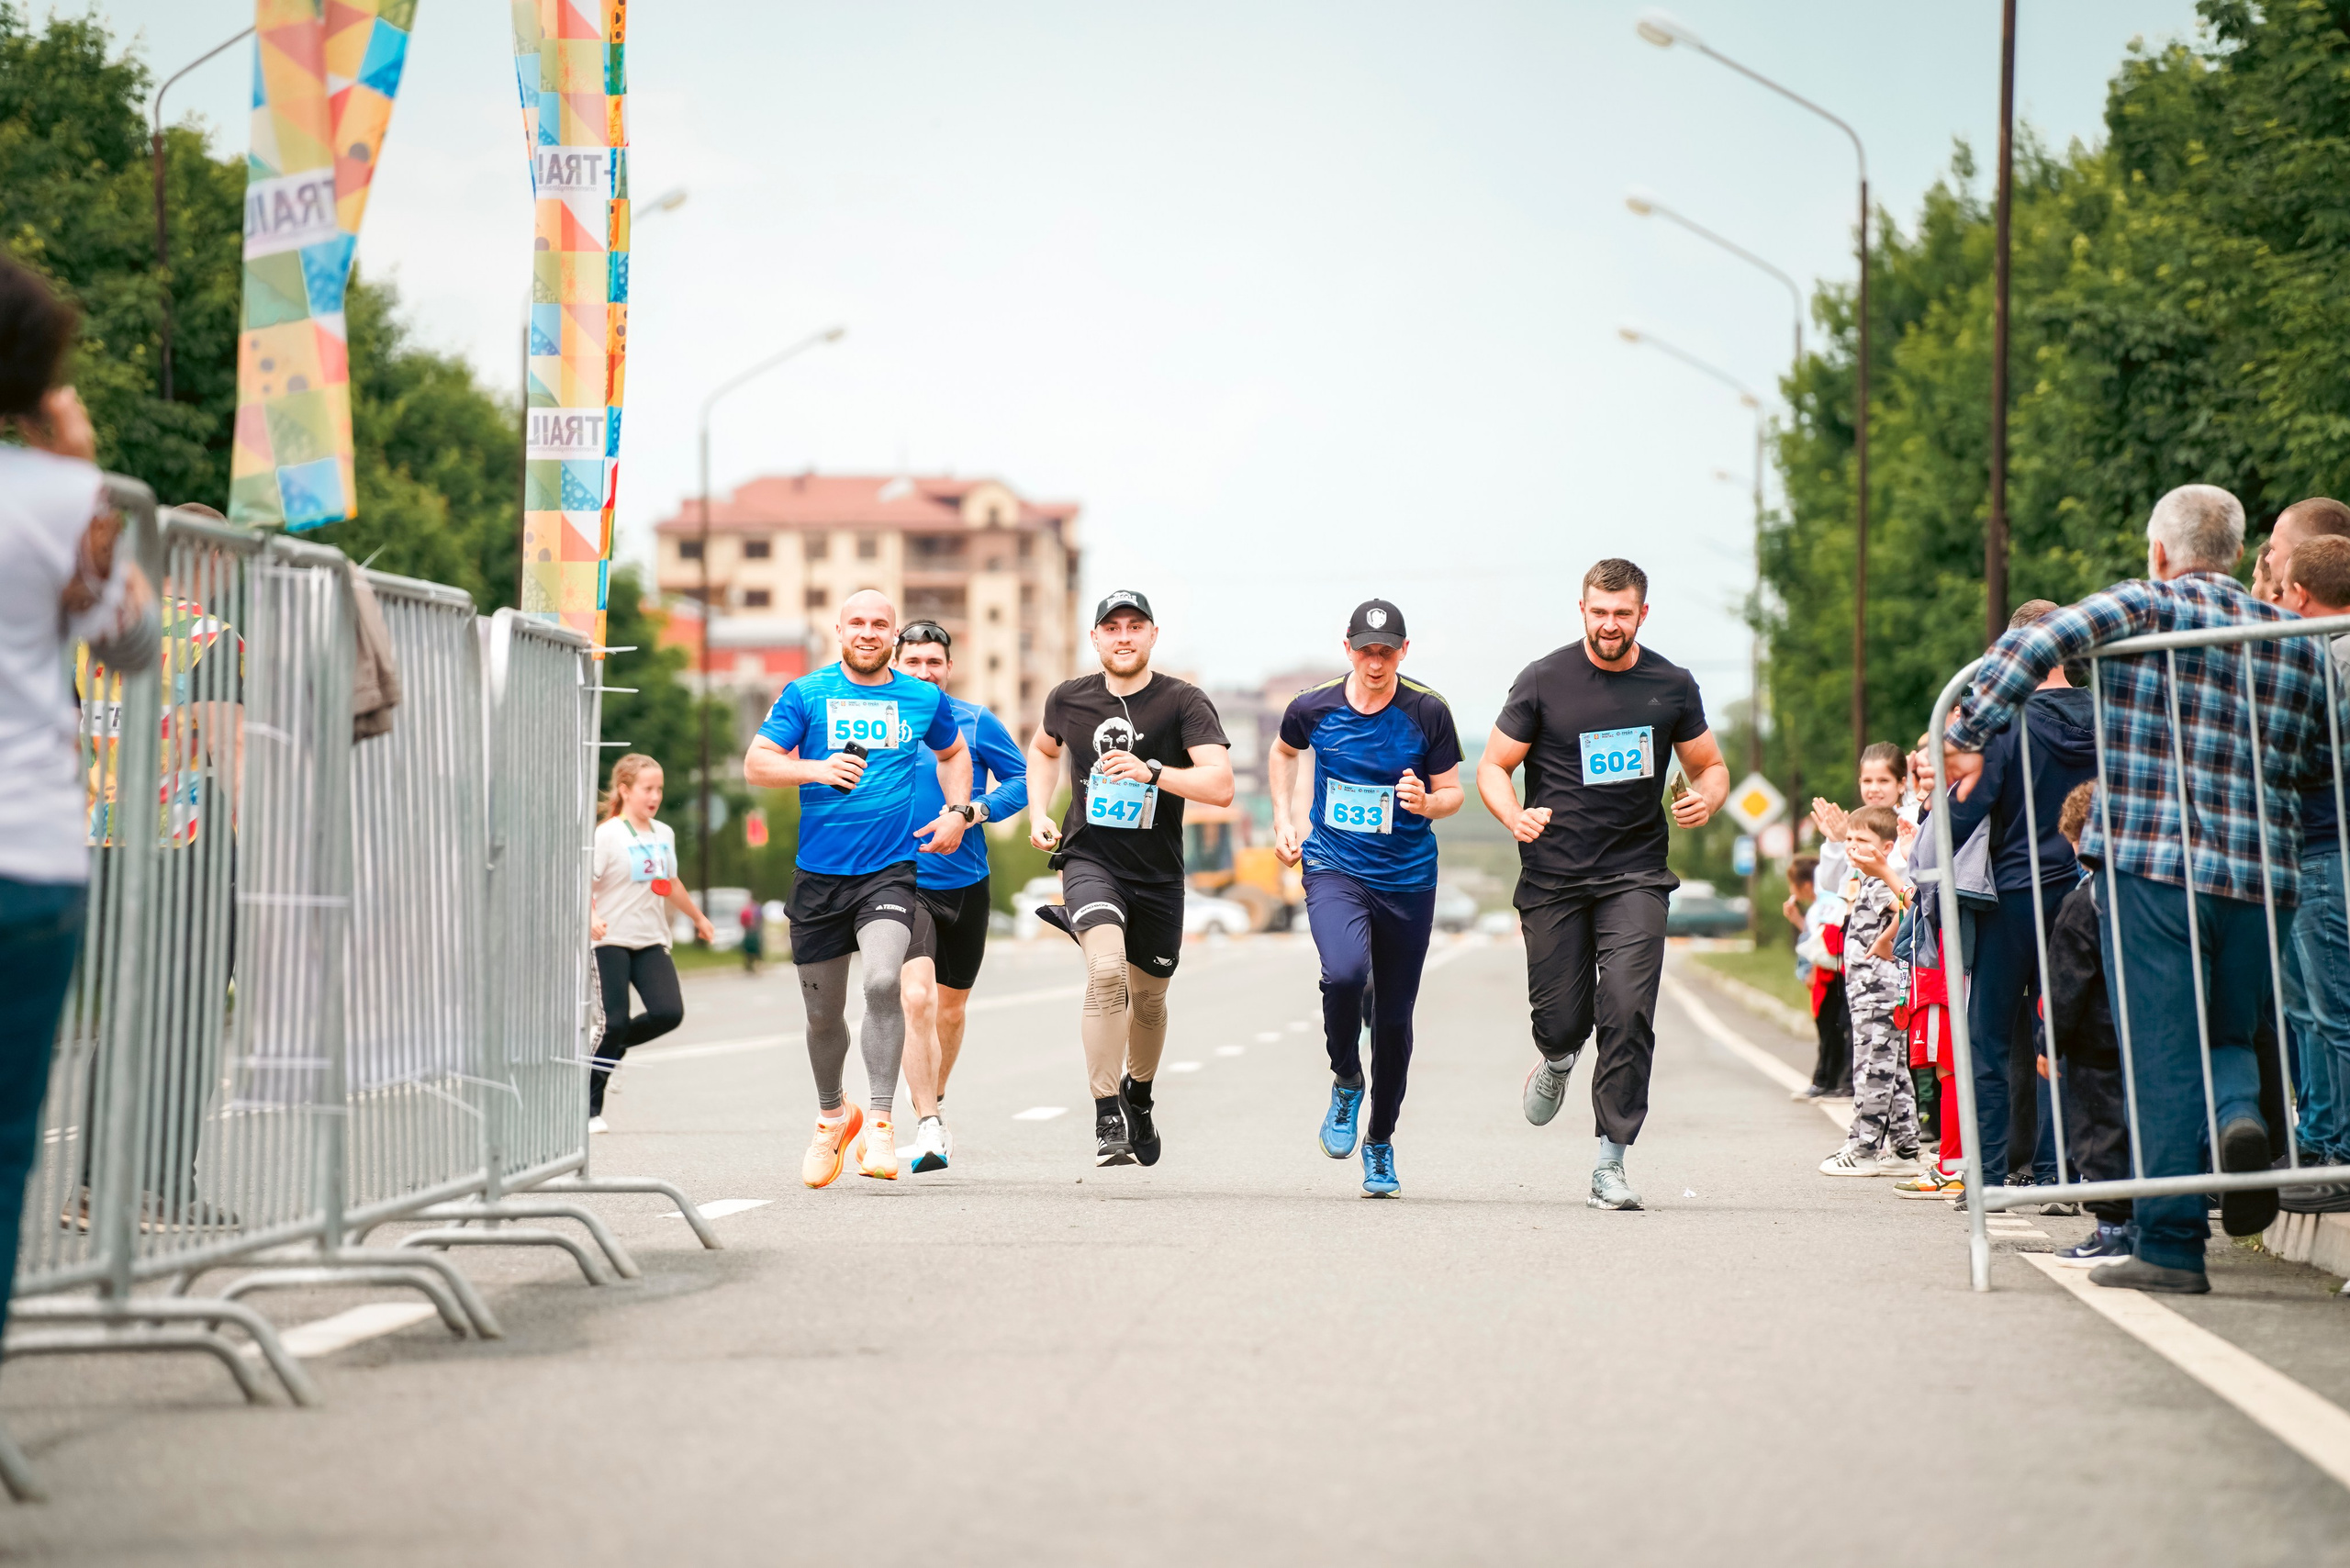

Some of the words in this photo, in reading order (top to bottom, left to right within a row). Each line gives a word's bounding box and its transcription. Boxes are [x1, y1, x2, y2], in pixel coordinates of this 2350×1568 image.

[834, 720, 888, 741] 590
[1590, 749, 1642, 775] 602
[1091, 797, 1143, 822] 547
[1334, 803, 1383, 826] 633
